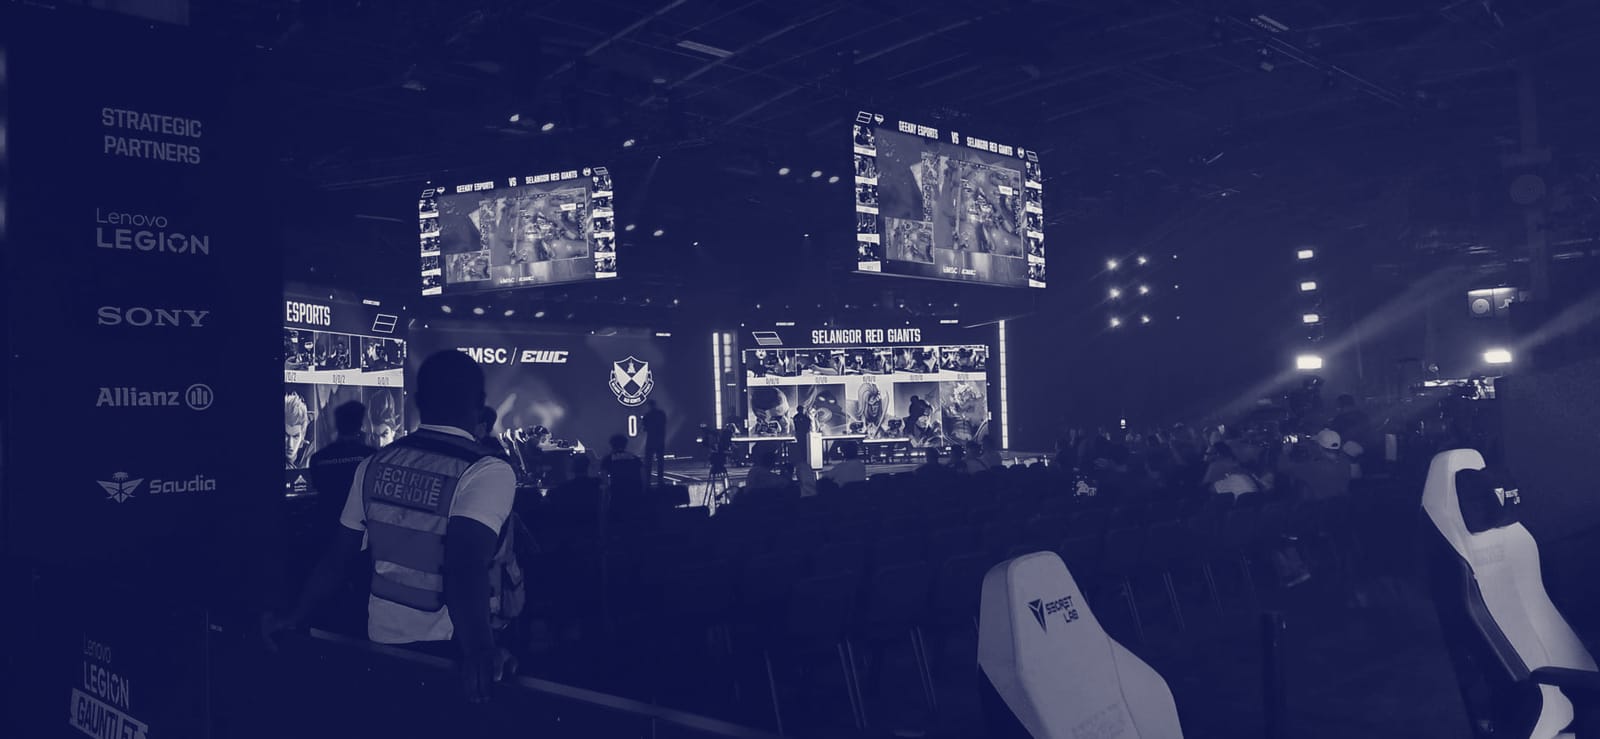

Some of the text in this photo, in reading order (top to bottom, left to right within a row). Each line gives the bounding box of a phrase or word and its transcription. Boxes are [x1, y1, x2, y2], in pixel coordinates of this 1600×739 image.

[102, 107, 202, 138] STRATEGIC
[951, 131, 960, 145] VS
[104, 135, 200, 164] PARTNERS
[508, 177, 517, 187] VS
[96, 207, 168, 228] Lenovo
[96, 227, 209, 255] LEGION
[97, 306, 210, 327] SONY
[286, 301, 331, 326] ESPORTS
[811, 328, 921, 344] SELANGOR RED GIANTS
[520, 350, 569, 363] EWC
[96, 387, 180, 407] Allianz
[628, 415, 637, 437] 0
[149, 475, 216, 494] Saudia
[374, 480, 441, 506] NCENDIE
[83, 631, 112, 664] Lenovo
[83, 660, 129, 710] LEGION
